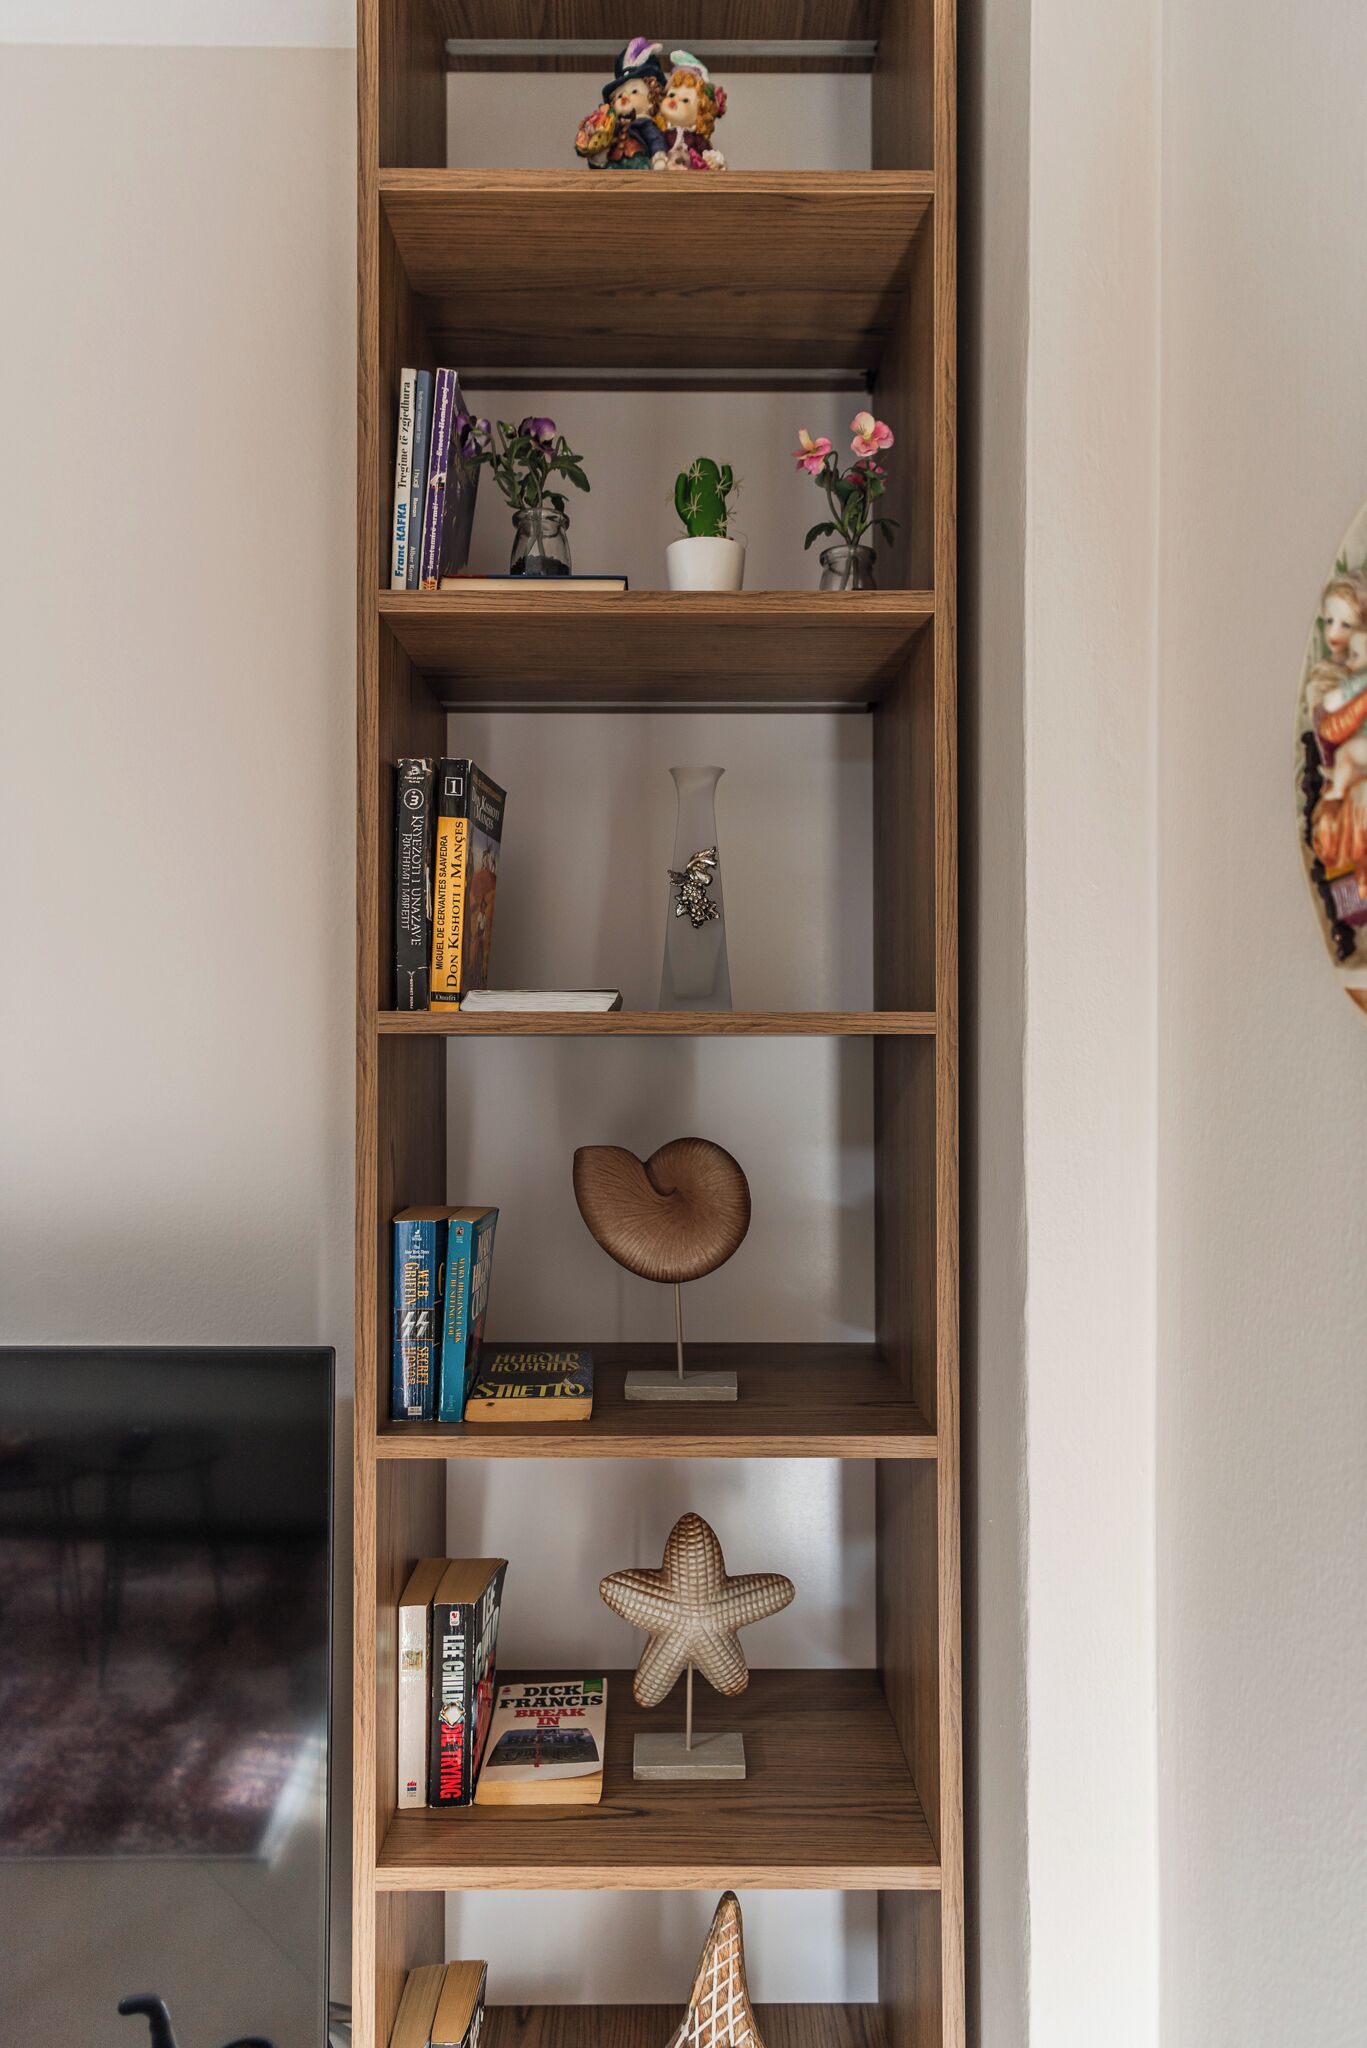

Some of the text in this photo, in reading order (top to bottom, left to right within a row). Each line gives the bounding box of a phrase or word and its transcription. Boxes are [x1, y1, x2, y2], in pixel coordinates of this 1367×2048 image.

[397, 382, 412, 488] Tregime të zgjedhura
[436, 430, 445, 456] Ernest
[395, 503, 408, 577] Franc KAFKA
[409, 795, 420, 806] 3
[450, 780, 457, 794] 1
[401, 833, 412, 880] RIKTHIMI
[411, 815, 425, 874] KRYEZOTI
[401, 888, 410, 931] MBRETIT
[411, 888, 422, 946] UNAZAVE
[436, 835, 448, 970] MIGUEL DE CERVANTES SAAVEDRA
[404, 1261, 419, 1305] GRIFFIN
[417, 1269, 429, 1298] W.E.B.
[448, 1290, 456, 1318] SEEING
[456, 1282, 464, 1314] HIGGINS
[447, 1321, 455, 1338] YOU
[455, 1316, 463, 1344] CLARK
[405, 1347, 417, 1385] HONOR
[416, 1346, 429, 1386] SECRET
[490, 1361, 581, 1373] ROBBINS
[495, 1352, 580, 1363] HAROLD
[474, 1382, 585, 1398] STILETTO
[442, 1635, 465, 1704] LEE CHILD
[499, 1694, 604, 1709] FRANCIS
[524, 1684, 583, 1697] DICK
[514, 1708, 586, 1718] BREAK
[536, 1717, 560, 1726] IN
[439, 1723, 464, 1799] DIE TRYING
